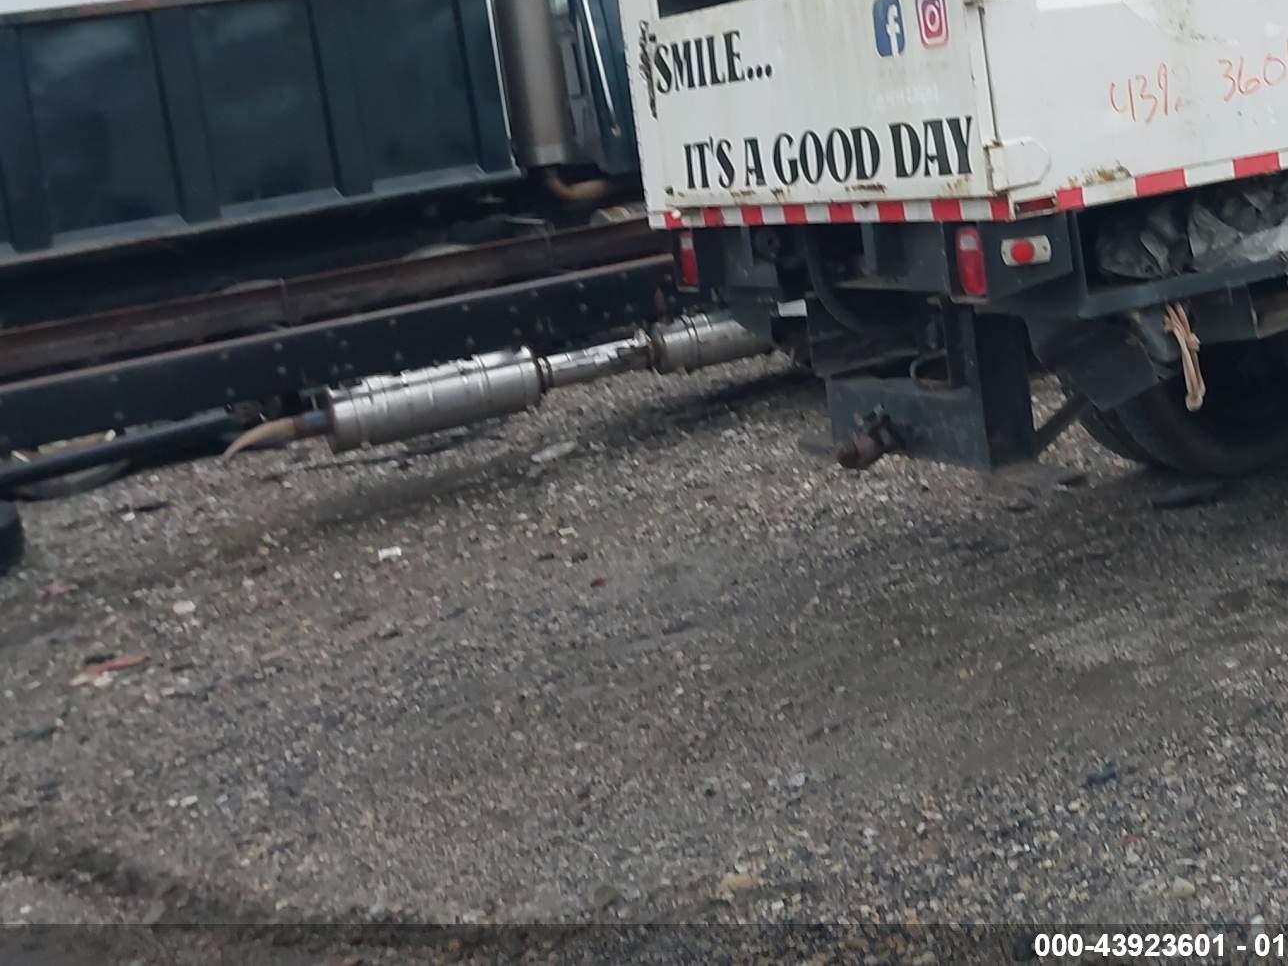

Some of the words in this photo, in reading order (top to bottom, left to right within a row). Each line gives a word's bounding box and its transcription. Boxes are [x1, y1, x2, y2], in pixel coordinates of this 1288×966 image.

[654, 29, 773, 95] SMILE...
[683, 135, 736, 190] IT'S
[743, 137, 768, 187] A
[772, 125, 882, 187] GOOD
[887, 115, 974, 179] DAY
